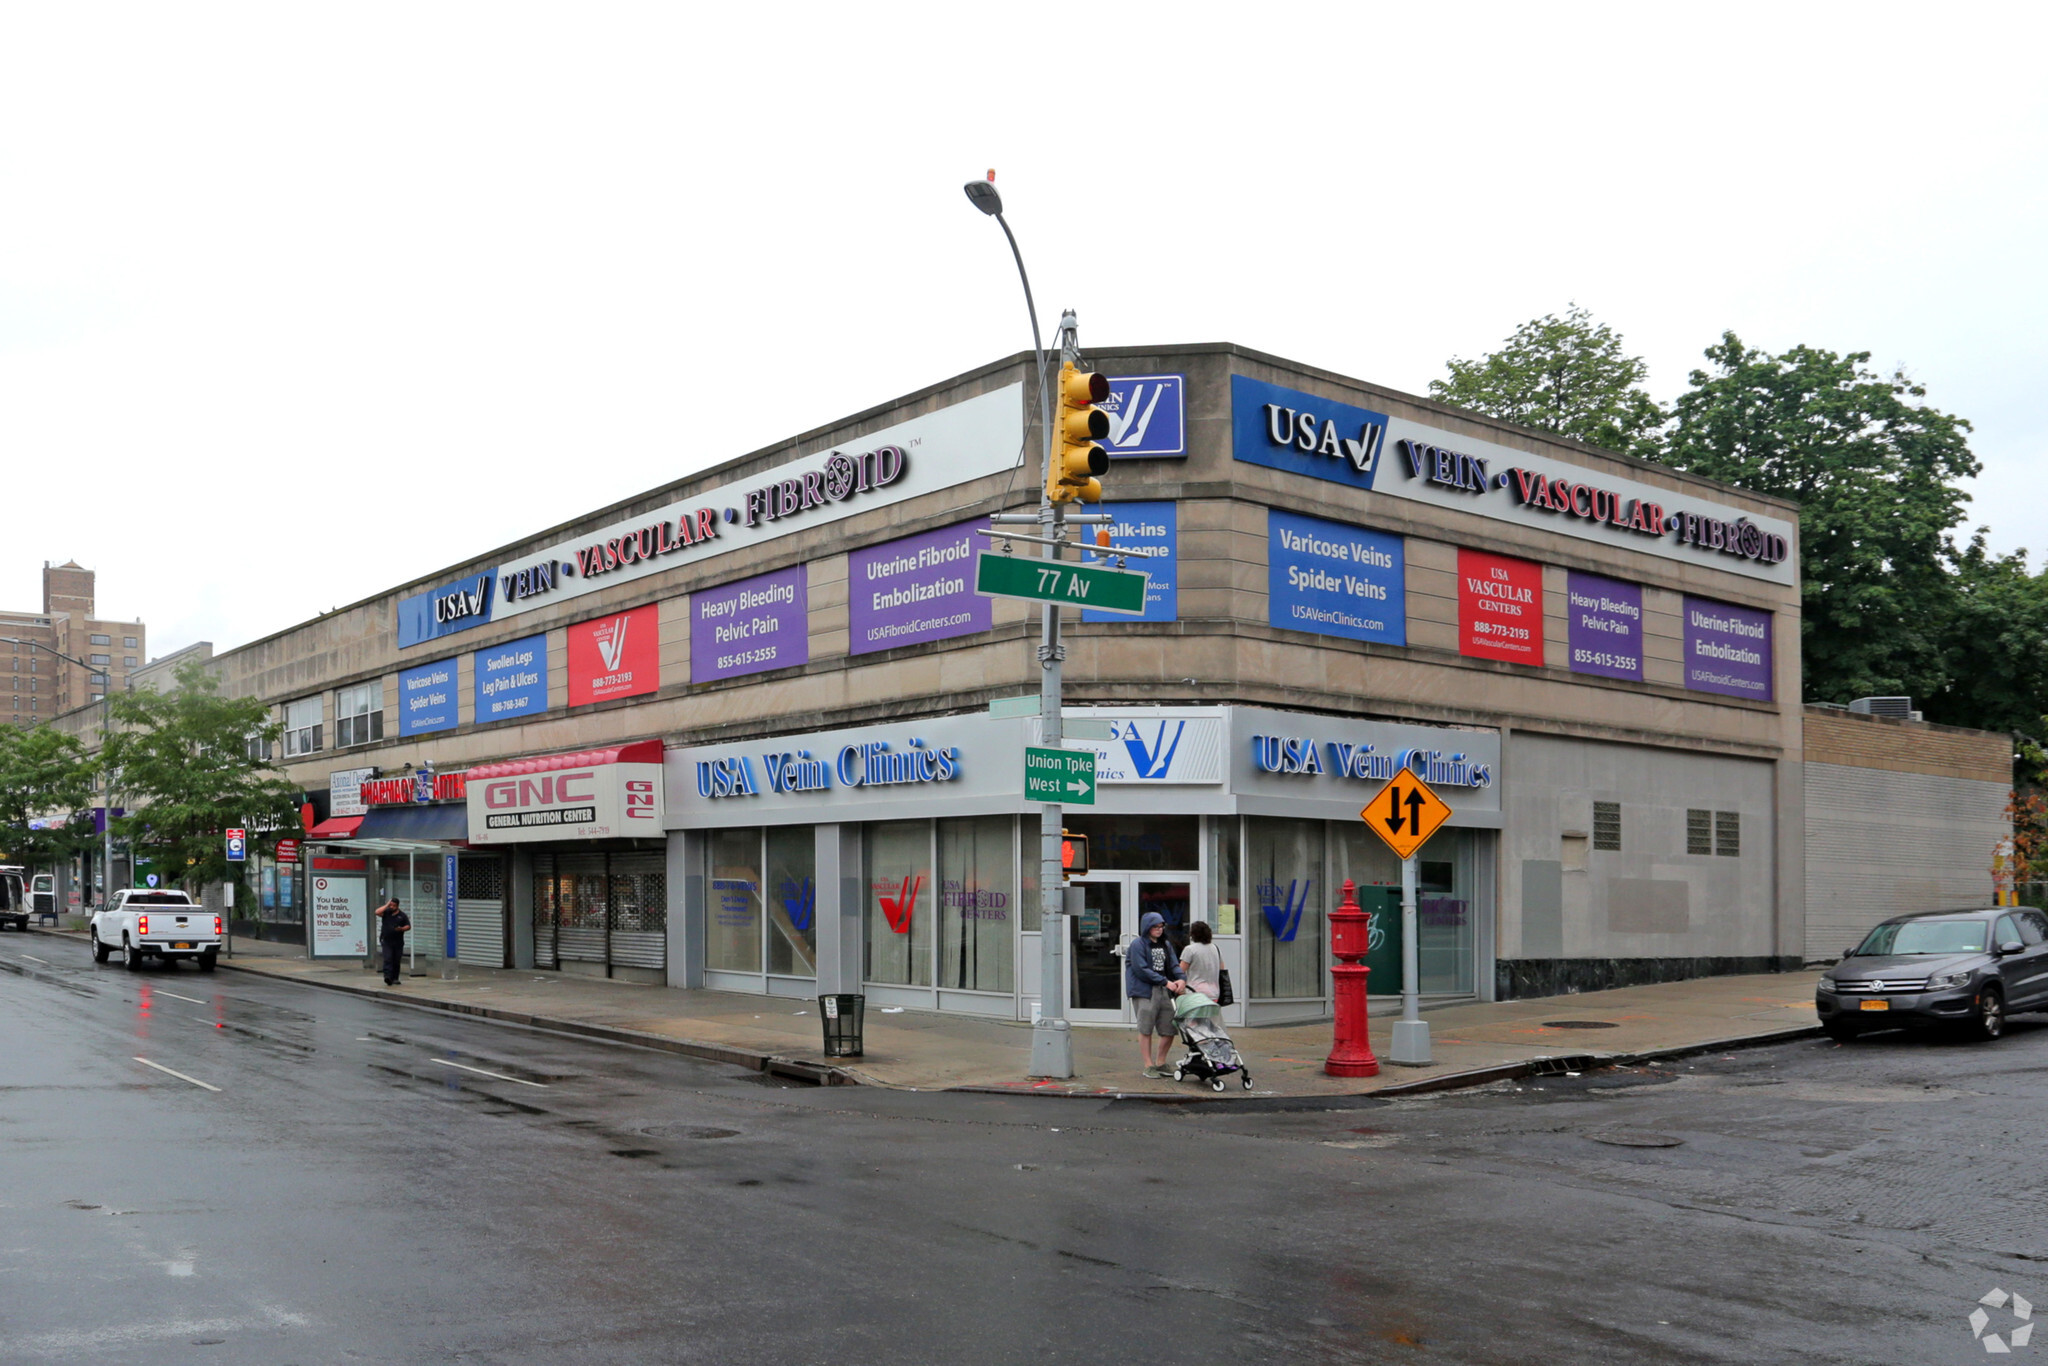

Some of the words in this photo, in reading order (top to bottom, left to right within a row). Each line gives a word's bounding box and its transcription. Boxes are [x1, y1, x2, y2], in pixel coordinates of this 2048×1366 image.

[1265, 403, 1345, 459] USA
[1401, 438, 1490, 494] VEIN
[1513, 467, 1666, 537] VASCULAR
[1682, 510, 1789, 564] FIBROID
[435, 590, 469, 623] USA
[500, 560, 557, 602] VEIN
[575, 508, 716, 577] VASCULAR
[743, 446, 904, 528] FIBROID
[868, 557, 918, 581] Uterine
[919, 537, 971, 576] Fibroid
[1280, 528, 1348, 560] Varicose
[1351, 542, 1392, 569] Veins
[1037, 568, 1061, 594] 77
[1067, 573, 1090, 598] Av
[1148, 582, 1169, 590] Most
[1288, 565, 1342, 592] Spider
[1344, 574, 1387, 601] Veins
[1491, 567, 1509, 582] USA
[702, 599, 738, 620] Heavy
[739, 583, 795, 611] Bleeding
[873, 578, 964, 611] Embolization
[1466, 577, 1533, 604] VASCULAR
[1292, 604, 1384, 631] USAVeinClinics.com
[1478, 599, 1522, 617] CENTERS
[1571, 592, 1600, 614] Heavy
[1601, 598, 1640, 620] Bleeding
[715, 621, 749, 644] Pelvic
[752, 615, 779, 637] Pain
[868, 613, 972, 641] USAFibroidCenters.com
[1474, 621, 1530, 644] 888-773-2193
[1582, 615, 1608, 636] Pelvic
[1610, 620, 1630, 636] Pain
[1691, 610, 1729, 632] Uterine
[1730, 618, 1766, 639] Fibroid
[487, 655, 515, 671] Swollen
[516, 651, 533, 667] Legs
[717, 646, 777, 670] 855-615-2555
[1574, 652, 1637, 671] 855-615-2555
[1695, 639, 1761, 665] Embolization
[407, 677, 432, 690] Varicose
[432, 671, 449, 684] Veins
[483, 681, 495, 697] Leg
[495, 676, 510, 692] Pain
[511, 674, 516, 688] &
[517, 672, 538, 687] Ulcers
[410, 696, 429, 712] Spider
[429, 692, 446, 706] Veins
[696, 756, 756, 798] USA
[762, 749, 829, 793] Vein
[837, 736, 957, 788] Clinics
[1027, 753, 1062, 771] Union
[1065, 757, 1094, 775] Tpke
[1096, 768, 1125, 779] nics
[1255, 735, 1325, 775] USA
[1328, 743, 1395, 781] Vein
[1399, 747, 1491, 789] Clinics
[360, 778, 414, 805] PHARMACY
[485, 772, 595, 810] GNC
[1029, 777, 1060, 793] West
[626, 780, 655, 819] GNC
[488, 815, 520, 828] GENERAL
[521, 810, 562, 826] NUTRITION
[563, 808, 593, 823] CENTER
[944, 880, 960, 889] USA
[330, 904, 350, 912] train,
[944, 889, 1007, 908] FIBROID
[330, 919, 352, 928] bags.
[335, 911, 353, 919] take
[960, 910, 1007, 920] CENTERS
